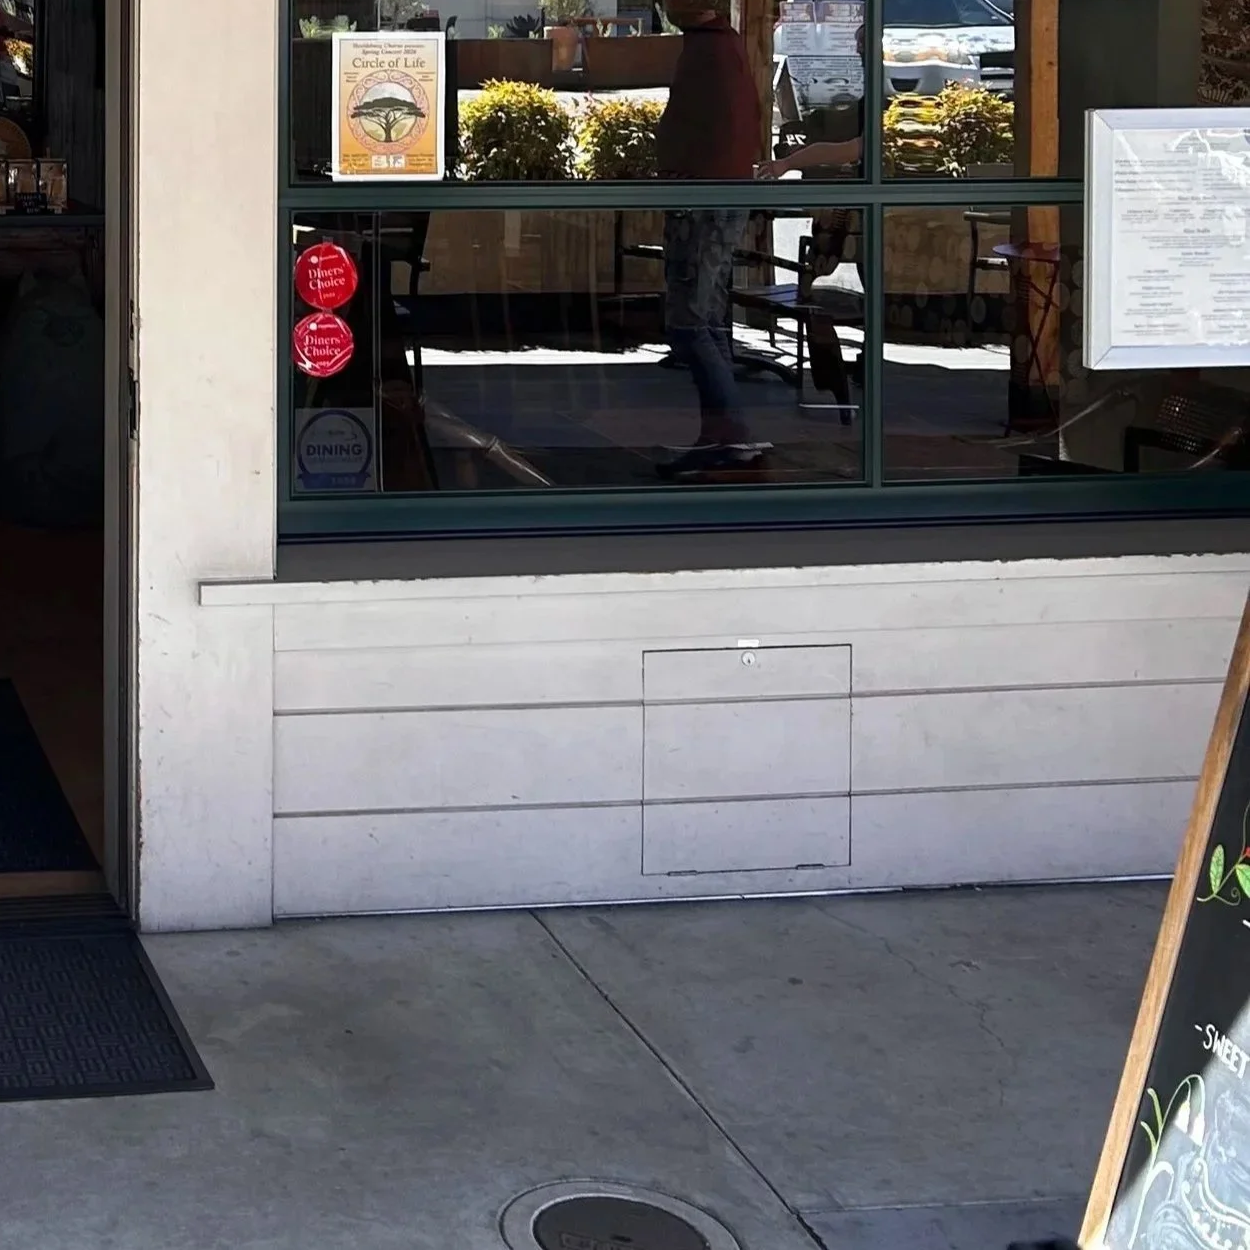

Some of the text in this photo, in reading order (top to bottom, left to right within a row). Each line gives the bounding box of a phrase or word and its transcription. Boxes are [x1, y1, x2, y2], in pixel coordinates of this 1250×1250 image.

[352, 57, 426, 68] Circle of Life
[308, 263, 346, 279] Diners'
[308, 276, 346, 291] Choice
[304, 333, 345, 347] Diners'
[304, 345, 341, 357] Choice
[306, 442, 363, 457] DINING
